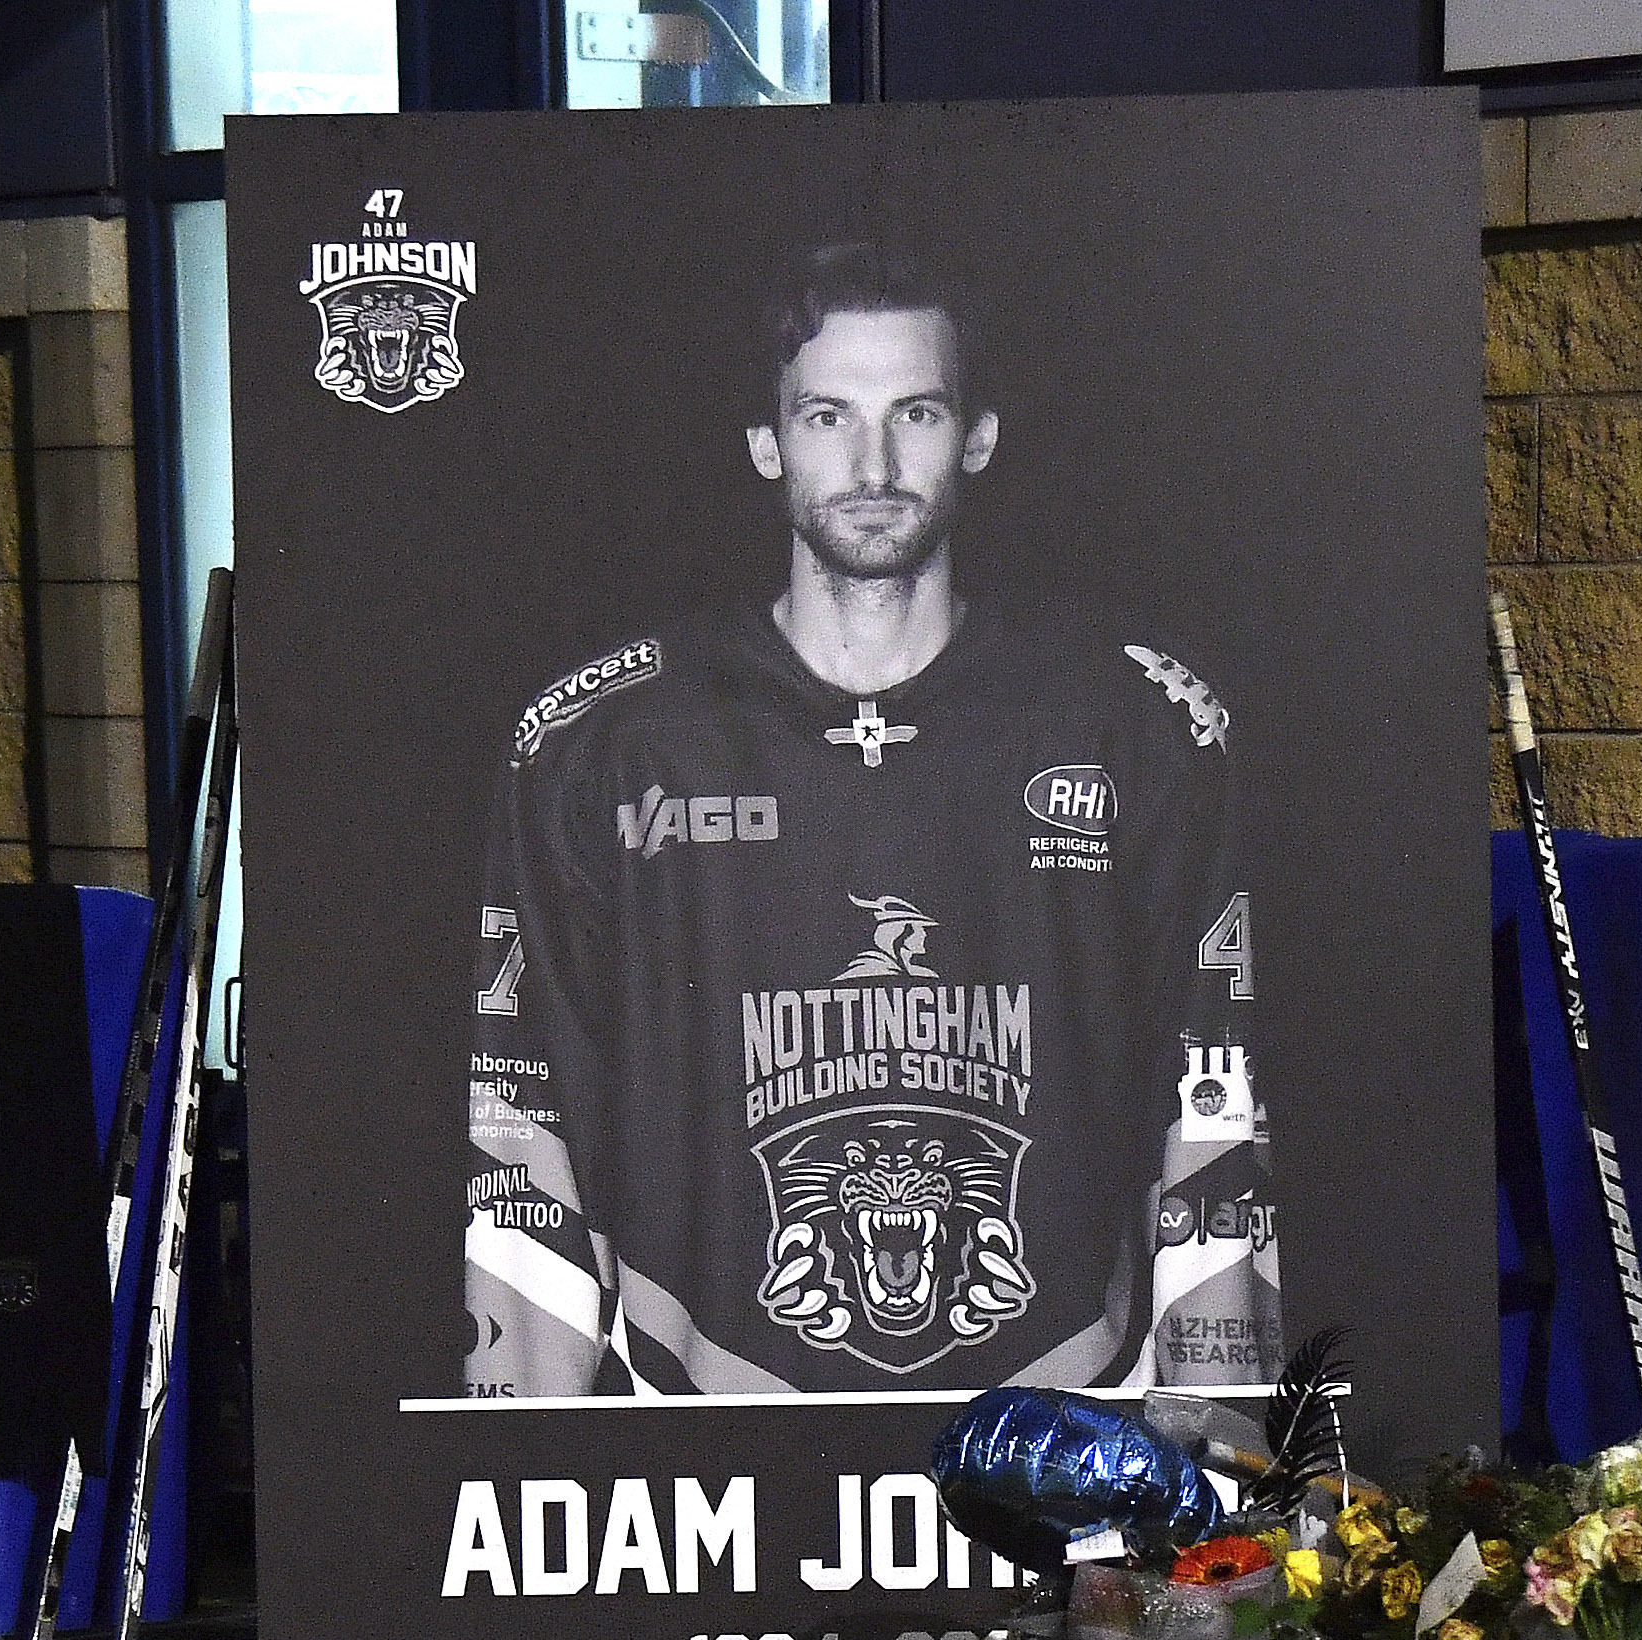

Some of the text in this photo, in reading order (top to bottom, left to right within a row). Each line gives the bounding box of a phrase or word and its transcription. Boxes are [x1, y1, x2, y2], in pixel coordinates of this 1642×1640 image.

[361, 222, 408, 238] ADAM
[364, 189, 405, 218] 47
[299, 241, 477, 295] JOHNSON
[741, 983, 1033, 1087] NOTTINGHAM
[746, 1051, 1032, 1130] BUILDING SOCIETY
[493, 1200, 563, 1229] TATTOO
[441, 1476, 756, 1597] ADAM
